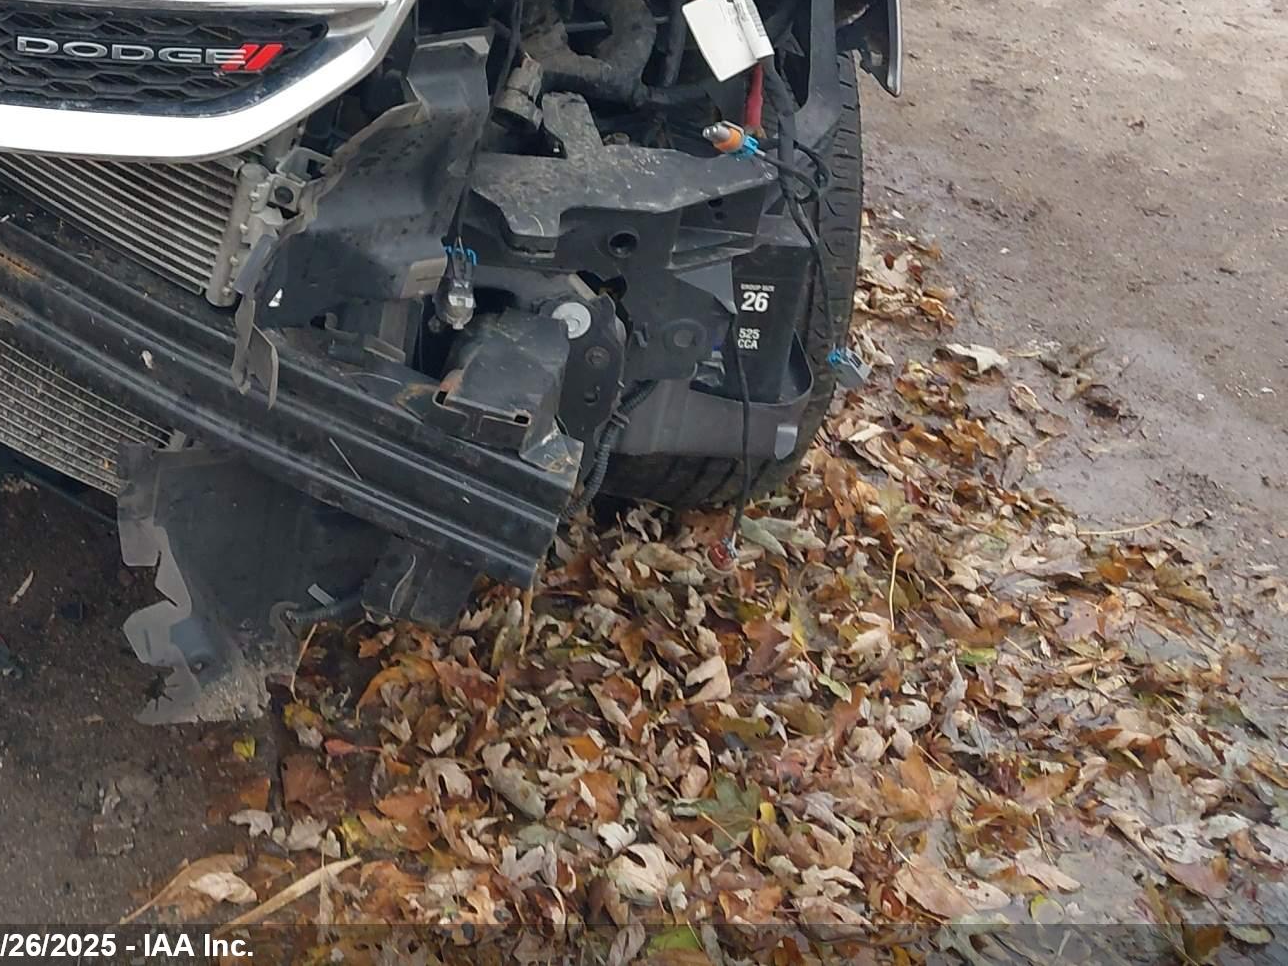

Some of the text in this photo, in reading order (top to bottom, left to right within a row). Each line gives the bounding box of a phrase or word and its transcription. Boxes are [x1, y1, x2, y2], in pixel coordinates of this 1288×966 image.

[17, 35, 247, 65] DODGE
[741, 291, 770, 312] 26
[739, 327, 760, 340] 525
[737, 338, 758, 350] CCA
